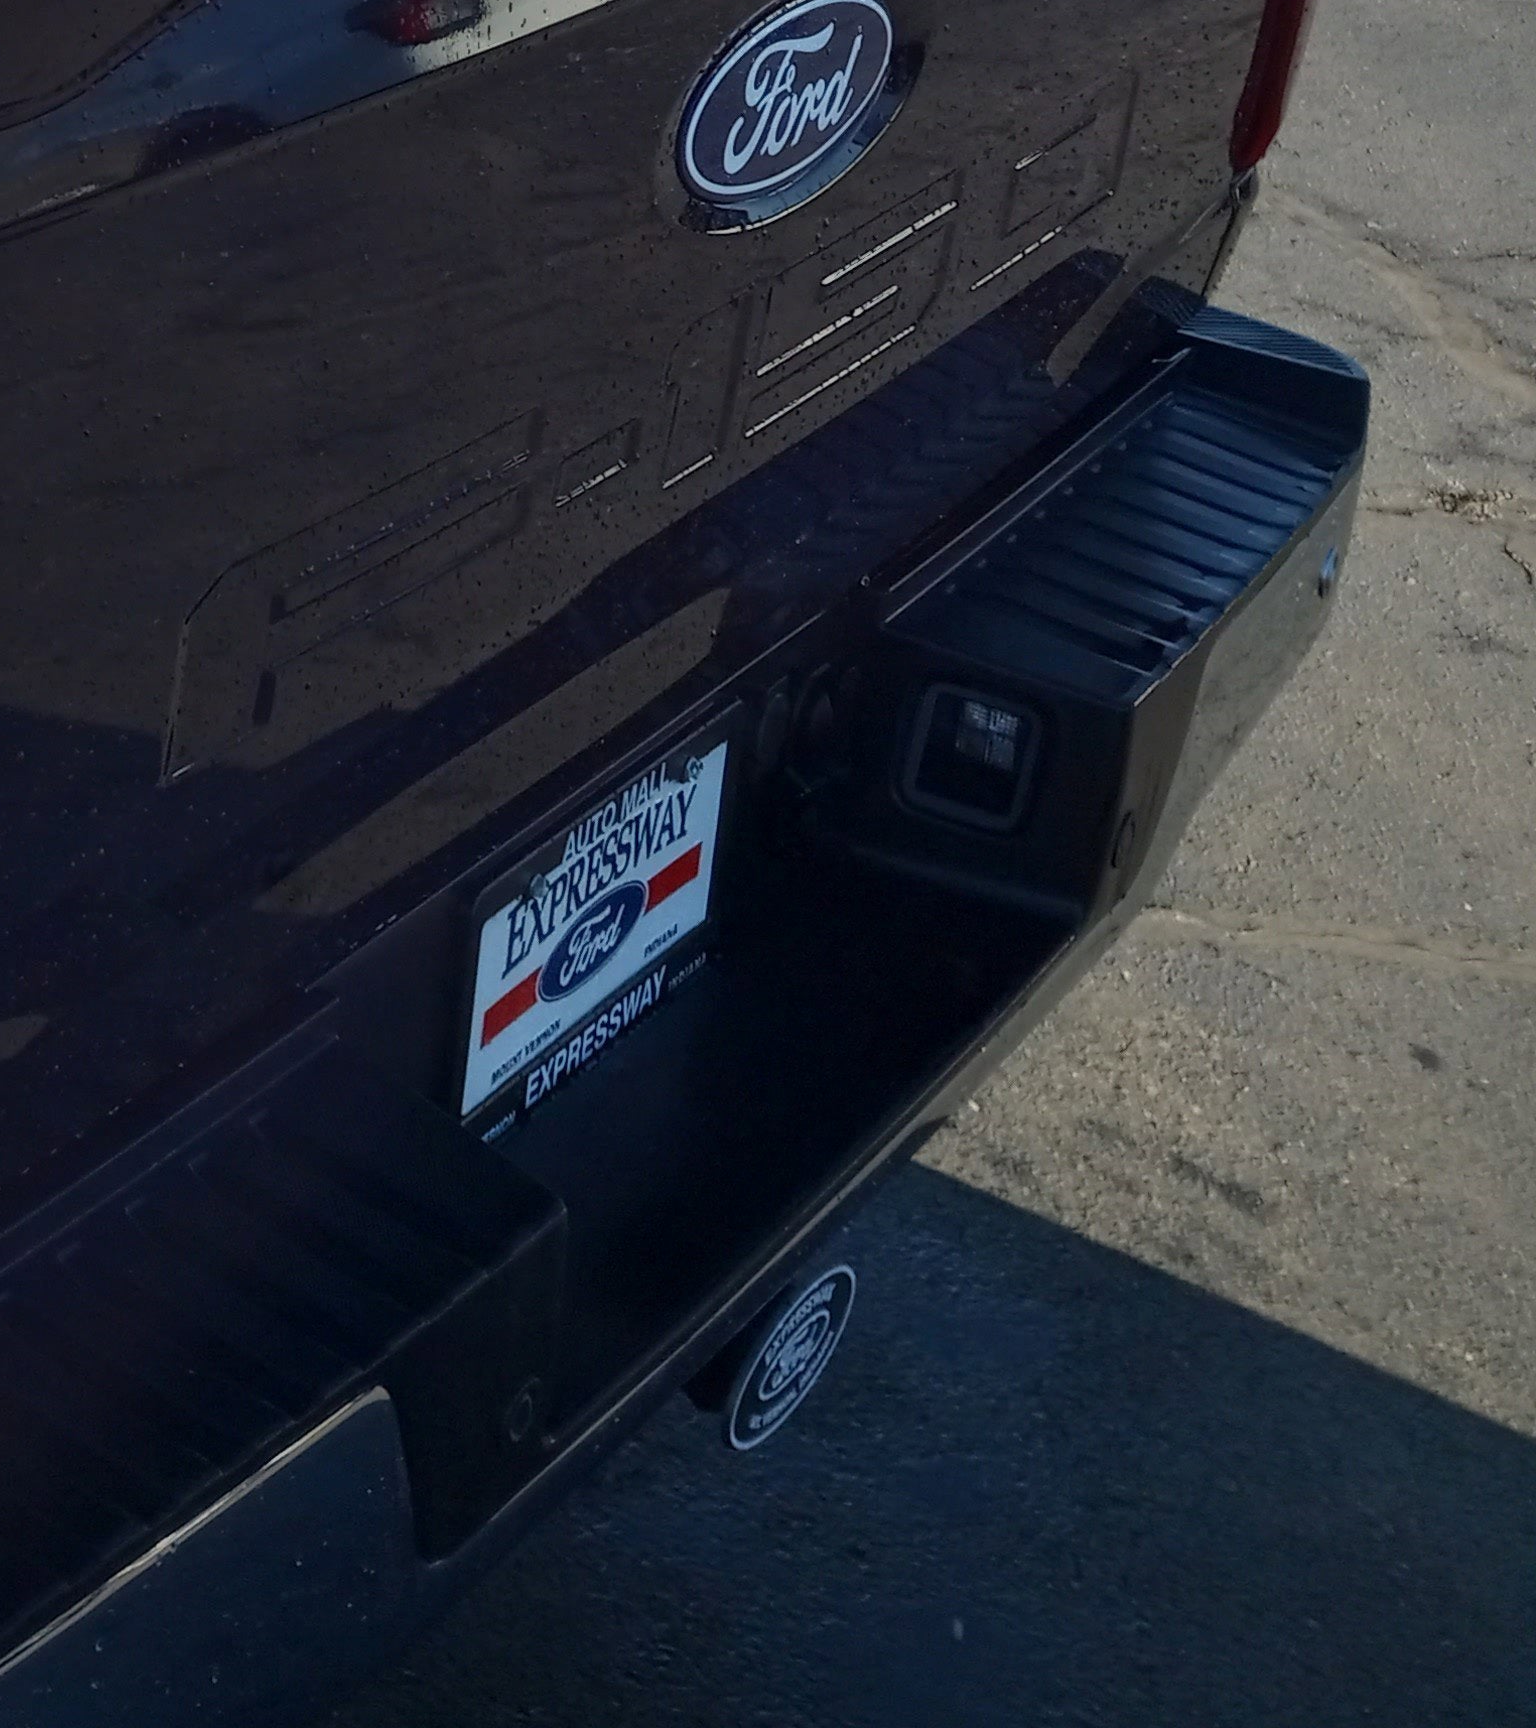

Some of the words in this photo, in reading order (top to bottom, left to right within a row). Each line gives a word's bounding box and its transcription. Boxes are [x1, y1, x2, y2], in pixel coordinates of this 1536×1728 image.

[723, 21, 863, 174] Ford
[502, 783, 697, 980] EXPRESSWAY
[562, 800, 617, 864] AUTO
[559, 903, 626, 987] Ford
[525, 964, 667, 1110] EXPRESSWAY
